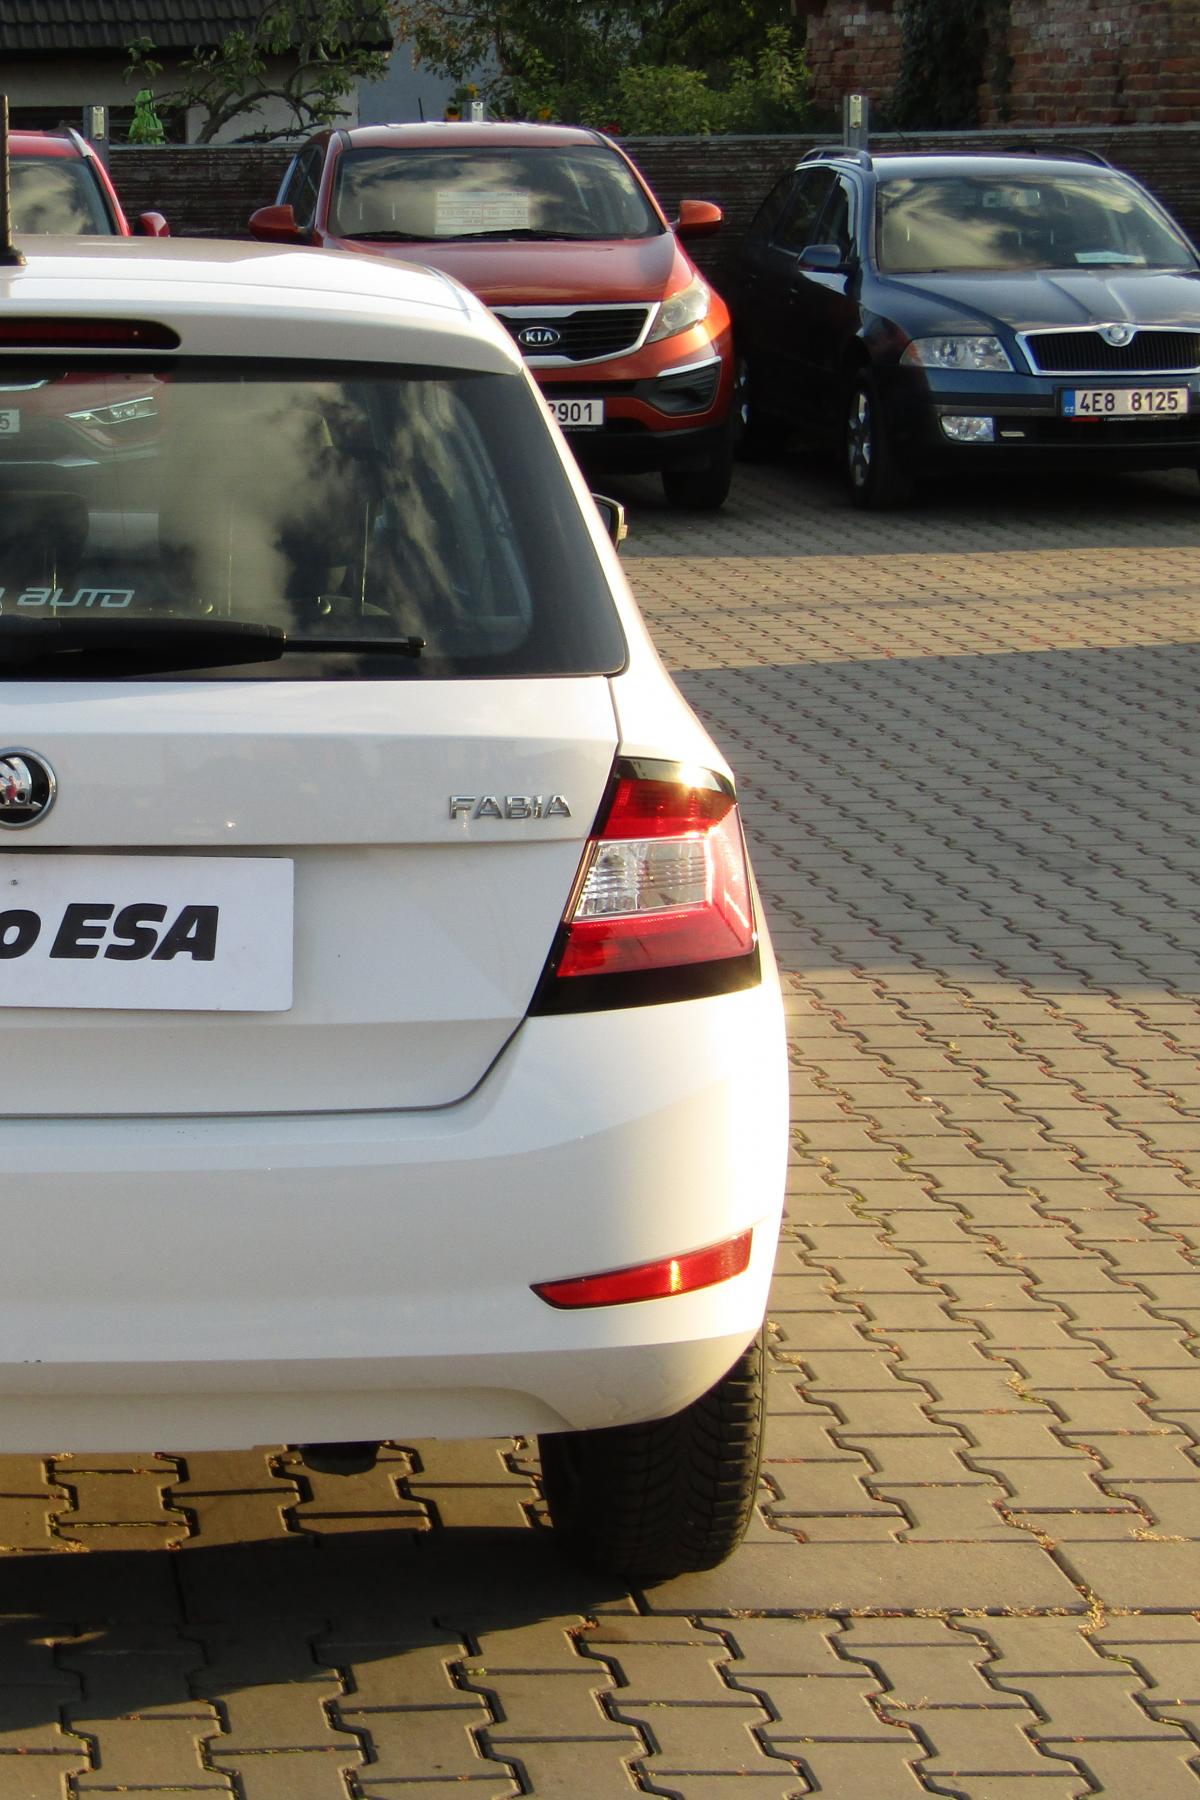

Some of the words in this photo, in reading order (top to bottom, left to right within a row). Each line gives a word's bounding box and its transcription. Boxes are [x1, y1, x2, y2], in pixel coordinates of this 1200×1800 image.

[525, 331, 554, 342] KIA
[1080, 393, 1115, 412] 4E8
[1131, 391, 1178, 411] 8125
[448, 795, 572, 819] FABIA
[49, 902, 220, 962] ESA
